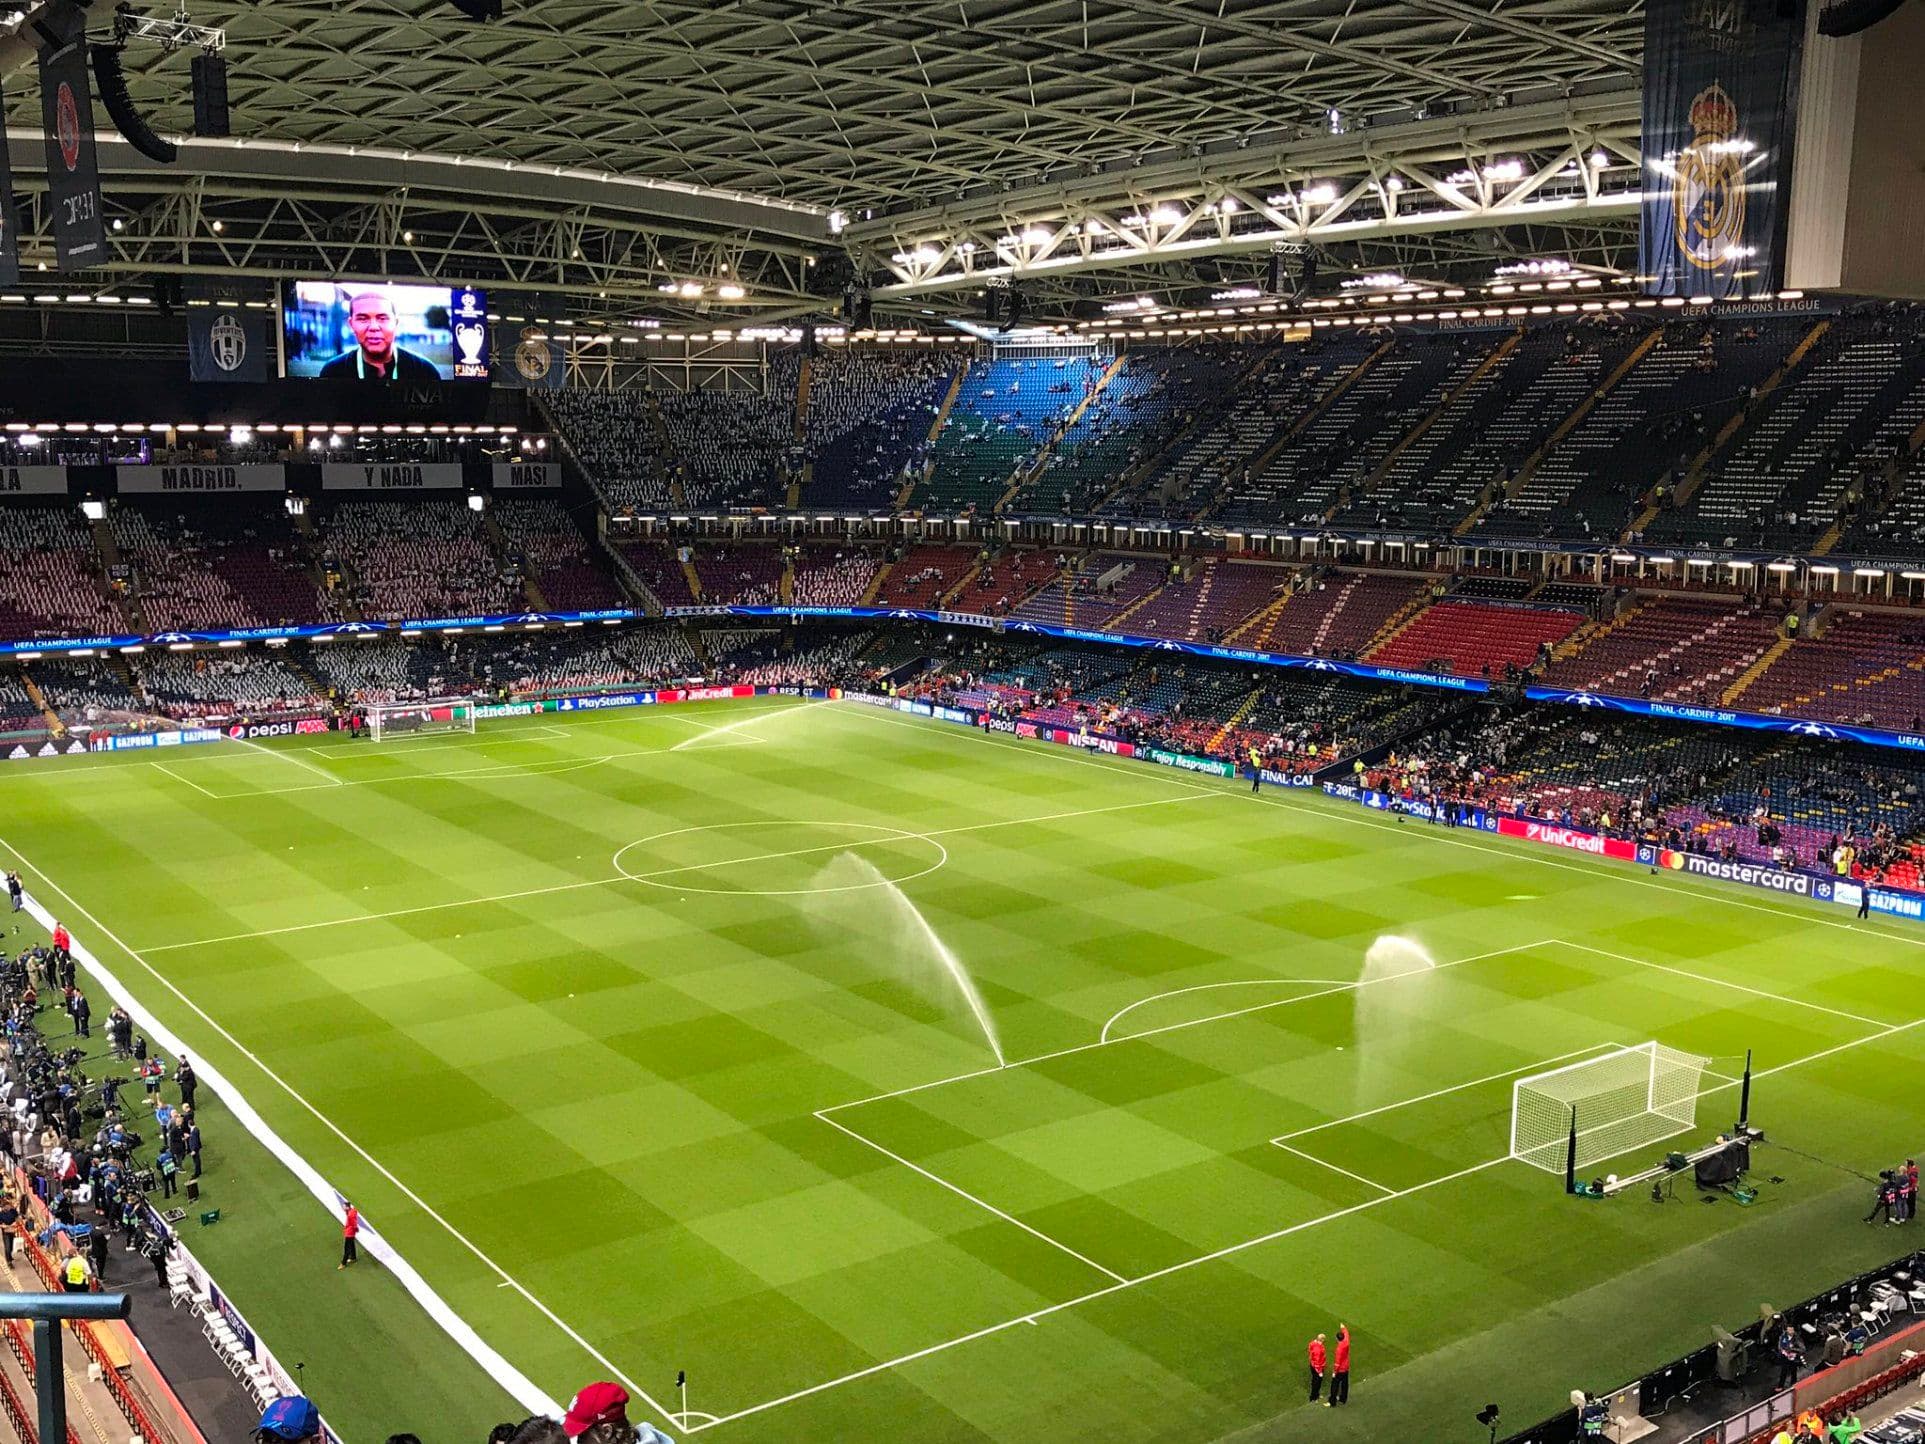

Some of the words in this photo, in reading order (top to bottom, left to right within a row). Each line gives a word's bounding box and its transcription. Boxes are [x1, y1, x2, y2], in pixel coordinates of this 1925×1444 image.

[1681, 307, 1708, 316] UEFA
[1711, 303, 1773, 315] CHAMPIONS
[1777, 300, 1820, 312] LEAGUE
[1439, 320, 1464, 330] FINAL
[1467, 318, 1503, 328] CARDIFF
[1506, 316, 1525, 326] 2017
[364, 467, 374, 487] Y
[381, 466, 423, 487] NADA
[511, 466, 547, 486] MAS!
[1665, 549, 1685, 558] FINAL
[1850, 560, 1871, 568] UEFA
[1872, 561, 1919, 570] CHAMPIONS
[14, 641, 34, 649] UEFA
[36, 638, 82, 648] CHAMPIONS
[83, 637, 112, 645] LEAGUE
[1376, 669, 1395, 677] UEFA
[1396, 670, 1437, 683] CHAMPIONS
[1438, 676, 1466, 687] LEAGUE
[780, 687, 814, 696] RESPCT
[578, 695, 636, 708] PlayStation
[1650, 703, 1676, 716] FINAL
[1678, 706, 1716, 720] CARDIFF
[1717, 711, 1736, 722] 2017
[248, 721, 292, 738] pepsi
[989, 718, 1015, 735] pepsi
[1068, 732, 1118, 754] NISSAN
[1898, 735, 1925, 747] UEFA
[1151, 749, 1175, 766] Enjoy
[1176, 754, 1227, 777] Responsibly
[1260, 769, 1288, 785] FINAL
[1541, 825, 1605, 854] UniCredit
[1688, 856, 1808, 894] mastercard
[1869, 892, 1922, 917] GAZPROM
